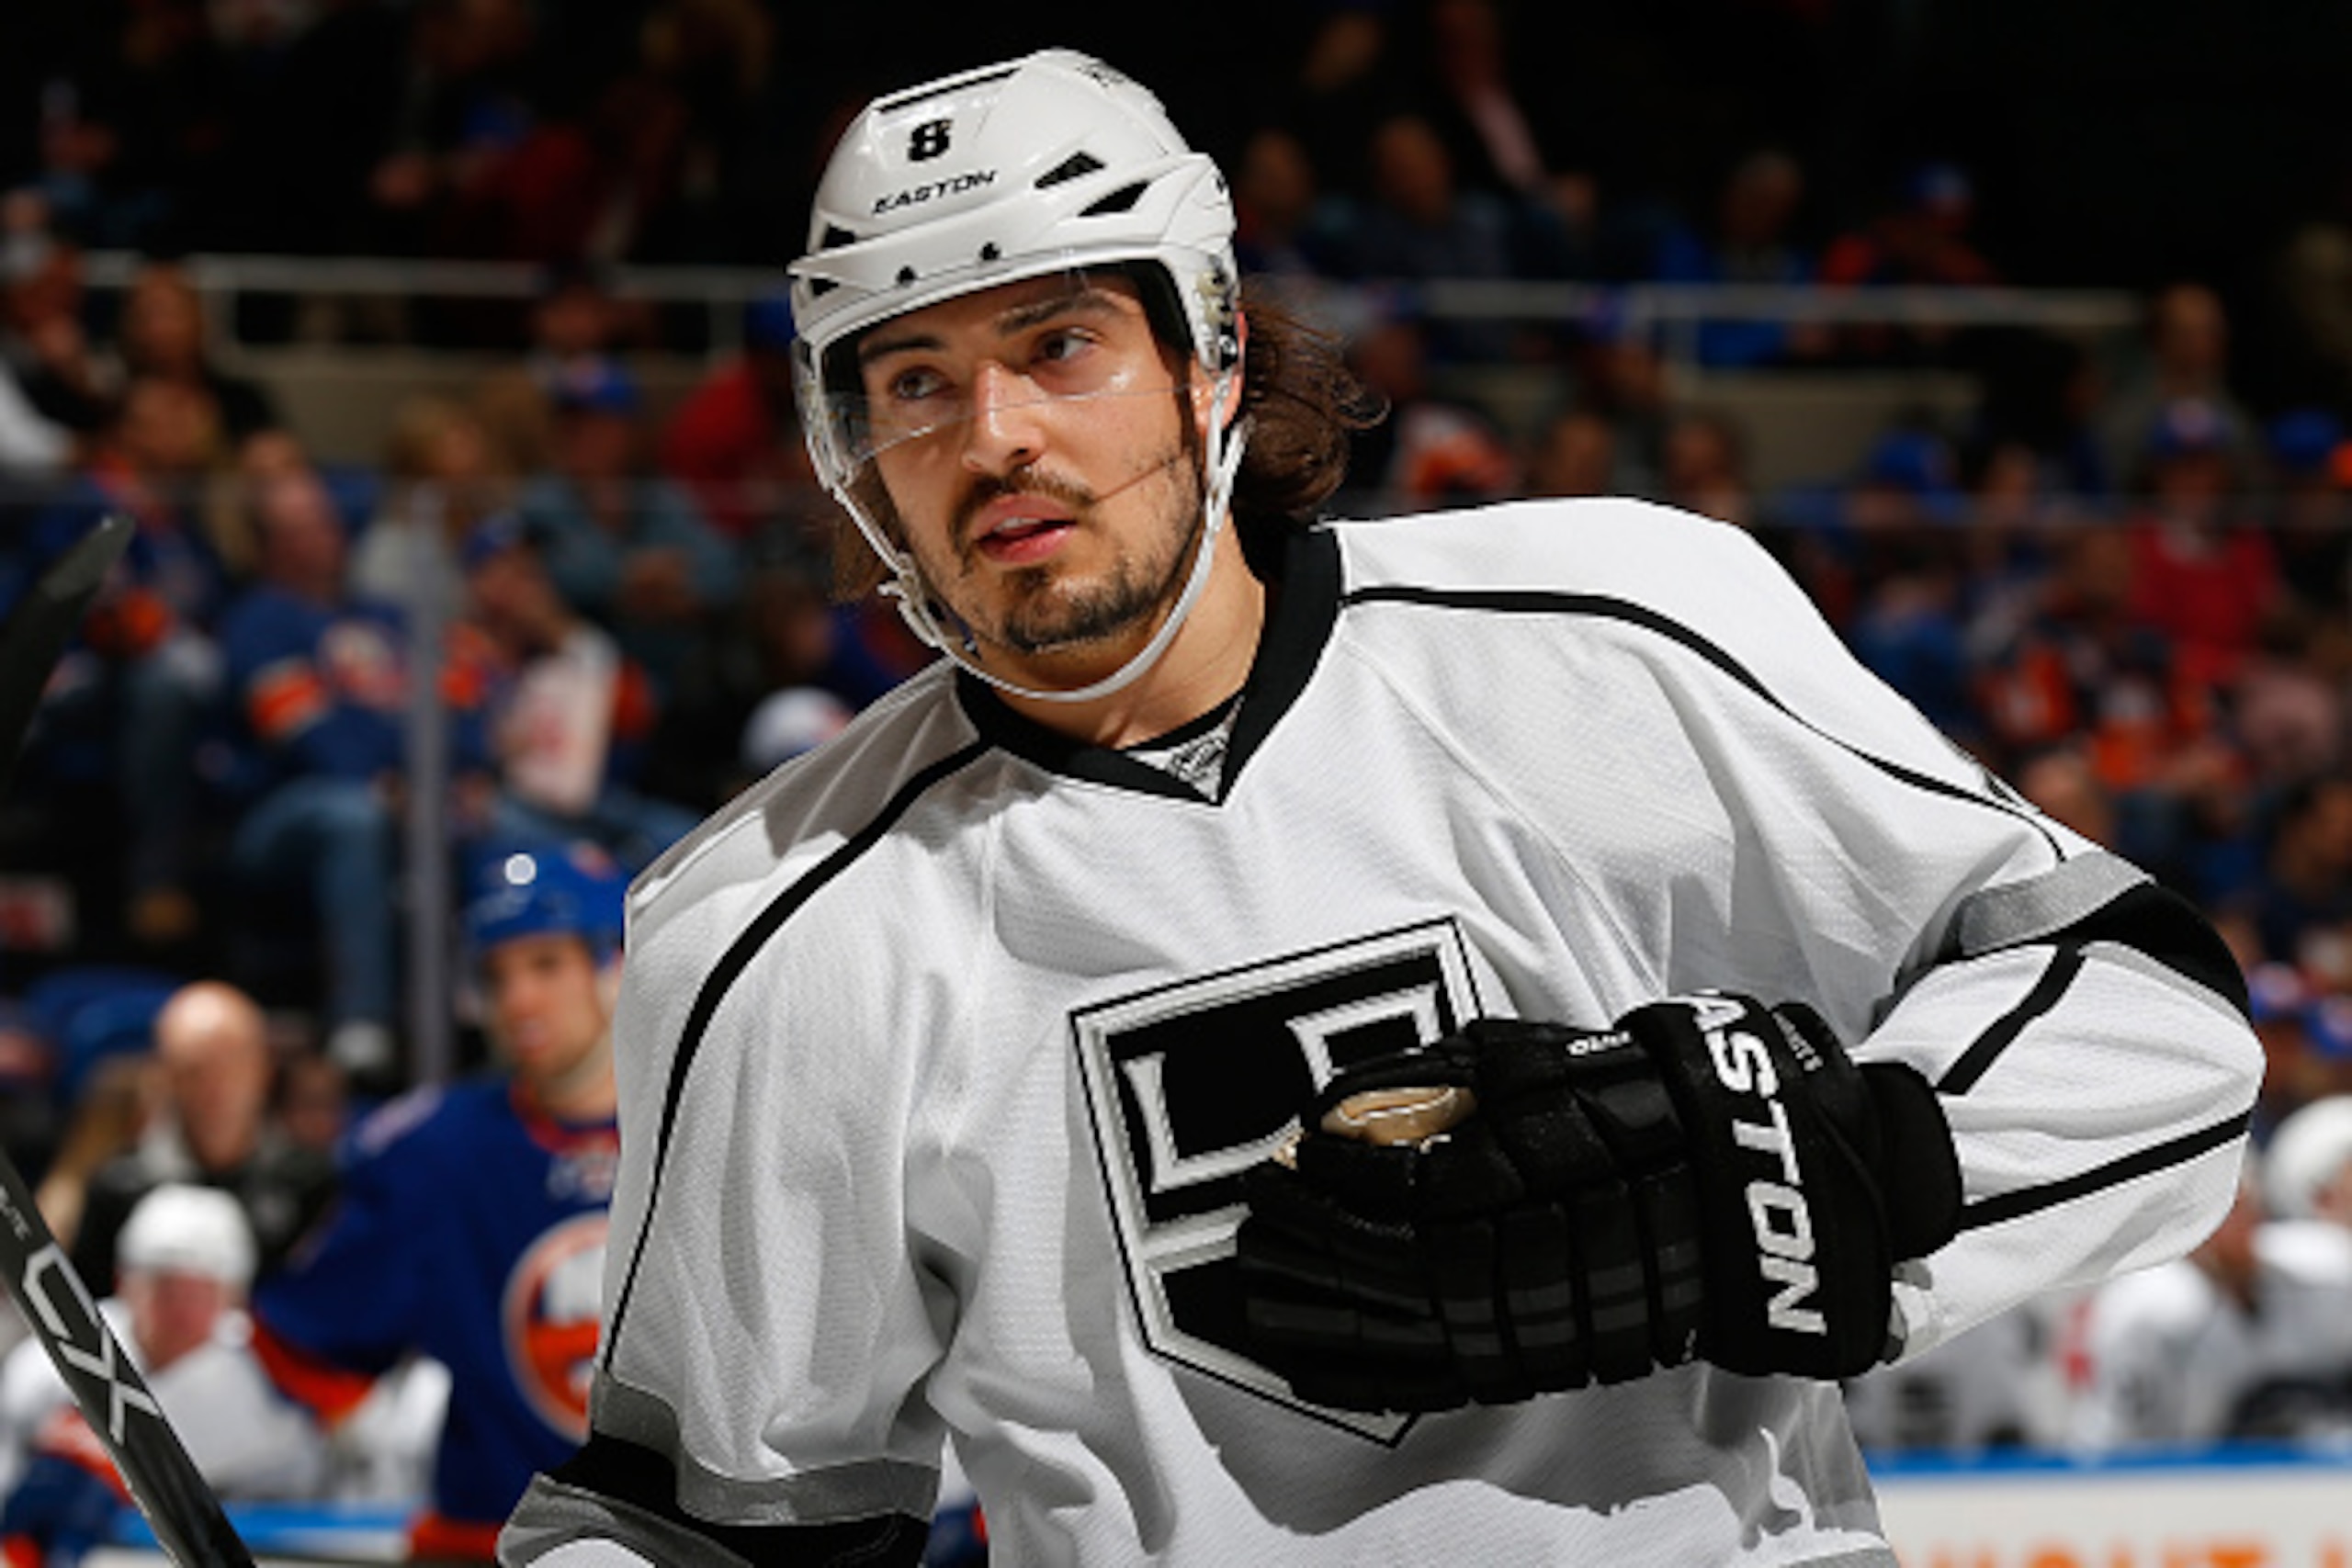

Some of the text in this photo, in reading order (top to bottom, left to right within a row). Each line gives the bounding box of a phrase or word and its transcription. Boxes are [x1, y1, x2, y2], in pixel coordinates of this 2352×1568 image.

[872, 169, 998, 214] EASTON
[909, 118, 953, 162] 8
[1690, 989, 1828, 1337] ASTON
[22, 1241, 164, 1447] CX
